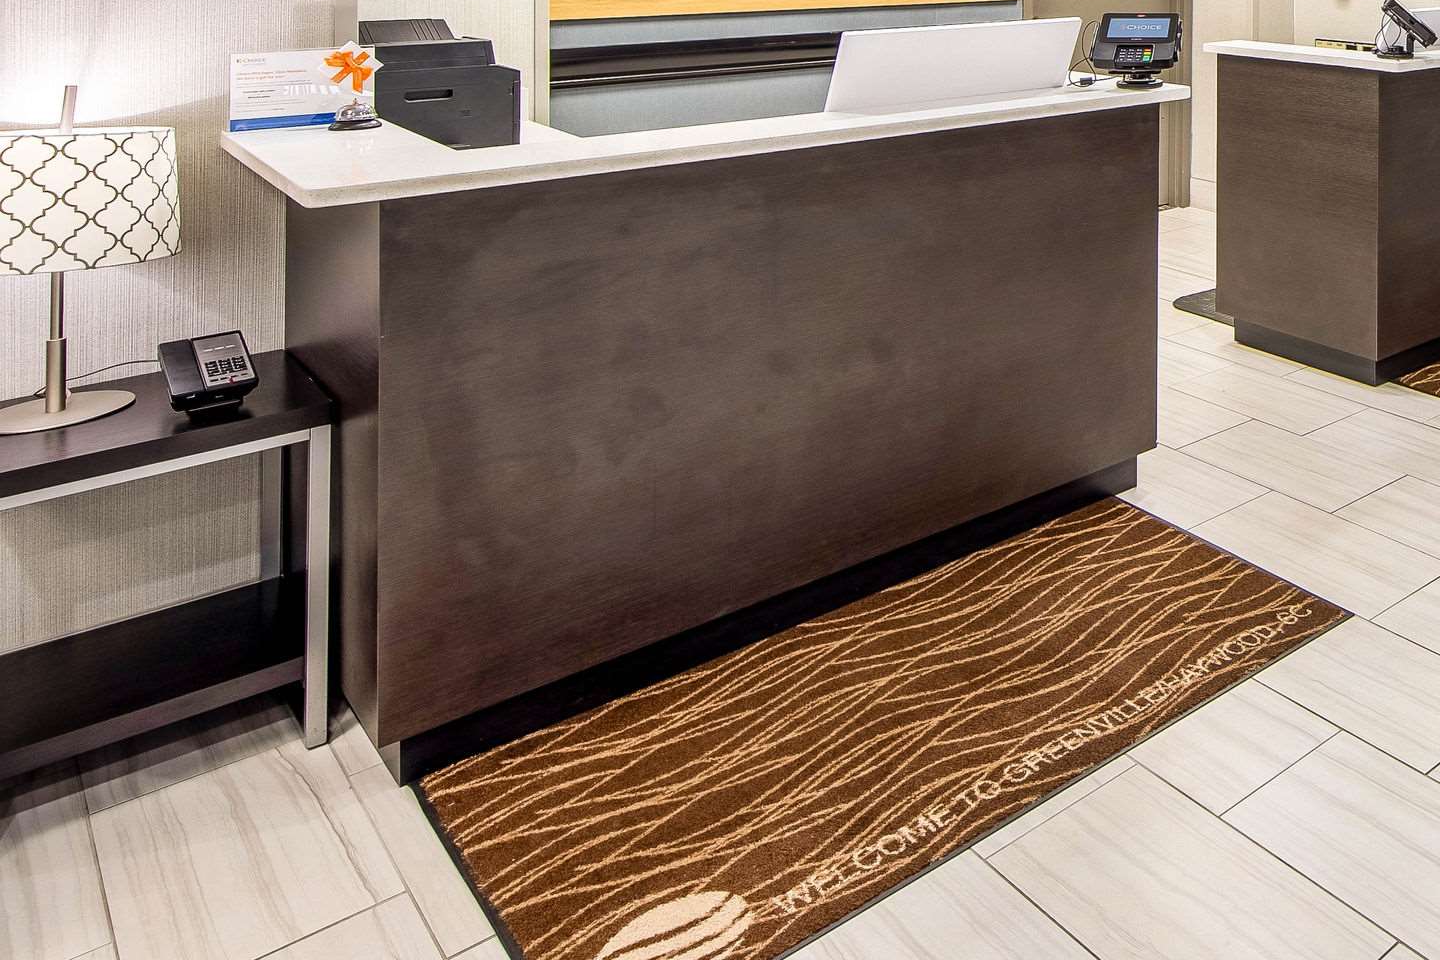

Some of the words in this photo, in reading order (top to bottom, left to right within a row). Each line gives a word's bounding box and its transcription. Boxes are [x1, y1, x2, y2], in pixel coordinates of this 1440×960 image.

[771, 803, 958, 914] WELCOME
[959, 778, 1002, 807] TO
[1275, 604, 1313, 626] SC
